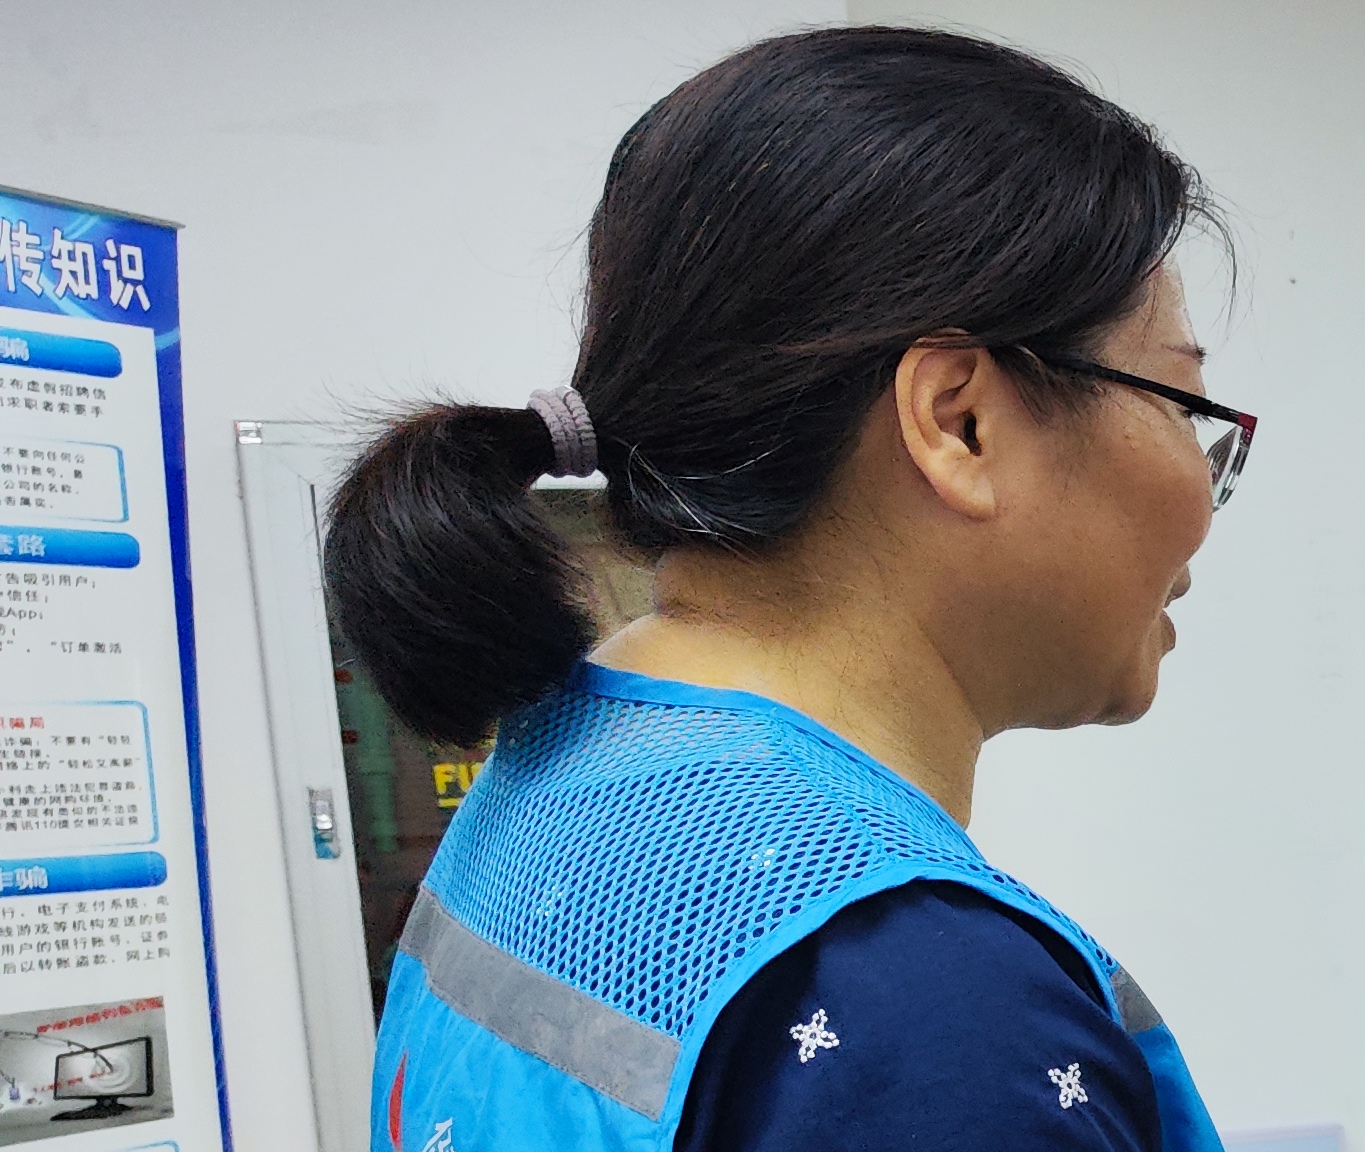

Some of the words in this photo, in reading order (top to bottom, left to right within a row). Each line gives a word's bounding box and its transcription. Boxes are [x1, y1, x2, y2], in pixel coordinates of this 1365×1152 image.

[0, 396, 104, 418] 求职者索要手
[0, 716, 45, 729] 骗局
